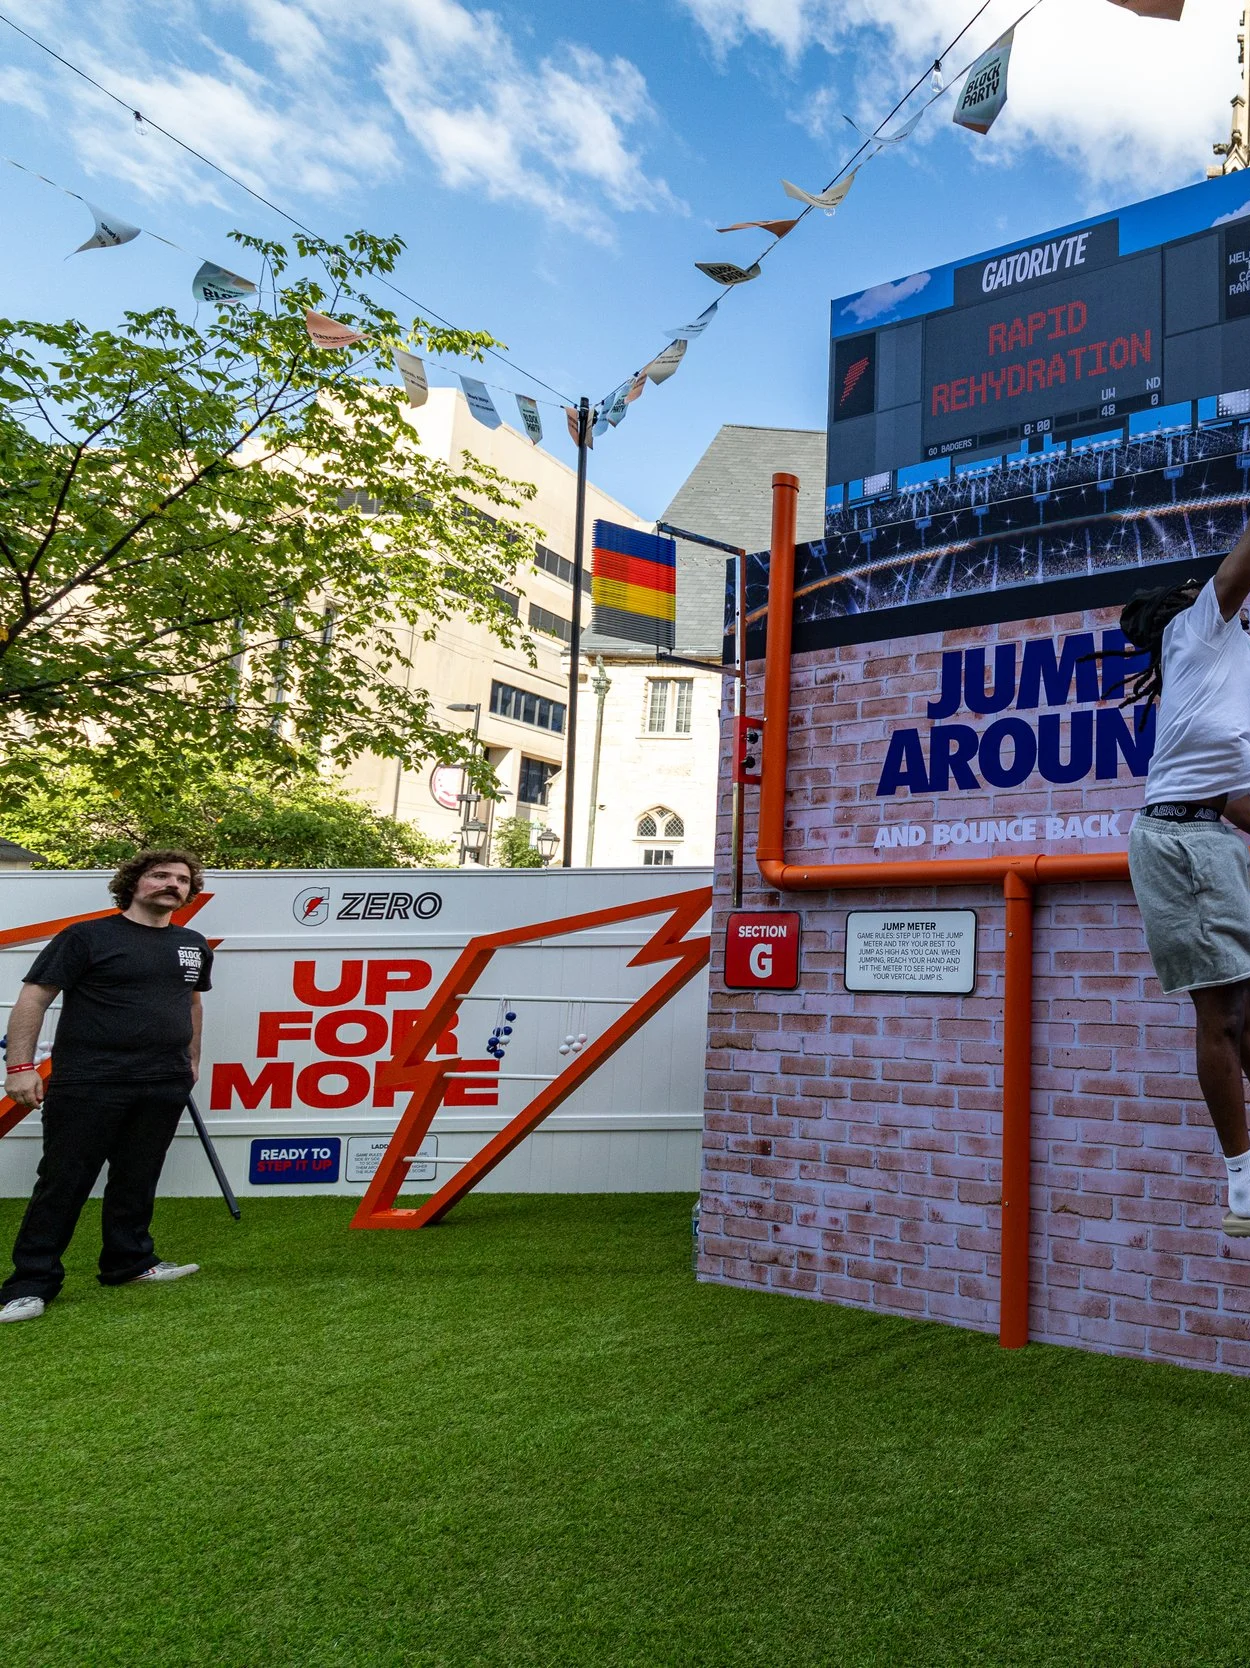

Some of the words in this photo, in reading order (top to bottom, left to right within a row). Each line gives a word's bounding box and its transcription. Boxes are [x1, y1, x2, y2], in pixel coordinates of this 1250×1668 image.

[966, 62, 1001, 95] BLOCK
[961, 78, 1000, 110] PARTY
[982, 232, 1089, 293] GATORLYTE
[987, 300, 1087, 356] RAPID
[931, 329, 1152, 416] REHYDRATION
[1101, 387, 1116, 400] UW
[1146, 376, 1160, 390] ND
[1101, 404, 1116, 417] 48
[1151, 393, 1159, 405] 0
[1024, 419, 1050, 435] 0:00
[928, 447, 938, 456] GO
[941, 438, 973, 454] BADGERS
[927, 629, 1150, 719] JUMP
[876, 703, 1156, 796] AROUN
[1150, 805, 1187, 817] AERO
[873, 826, 926, 849] AND
[933, 817, 1037, 846] BOUNCE
[1045, 813, 1122, 841] BACK
[336, 891, 443, 920] ZERO
[738, 925, 787, 938] SECTION
[882, 922, 905, 931] JUMP
[907, 922, 937, 931] METER
[177, 950, 202, 960] BLOCK
[179, 959, 202, 969] PARTY
[749, 943, 773, 979] G
[293, 959, 432, 1007] UP
[256, 1008, 460, 1058] FOR
[257, 1160, 292, 1172] STEP
[295, 1160, 309, 1171] IT
[312, 1160, 333, 1171] UP
[260, 1148, 309, 1161] READY
[311, 1147, 331, 1159] TO
